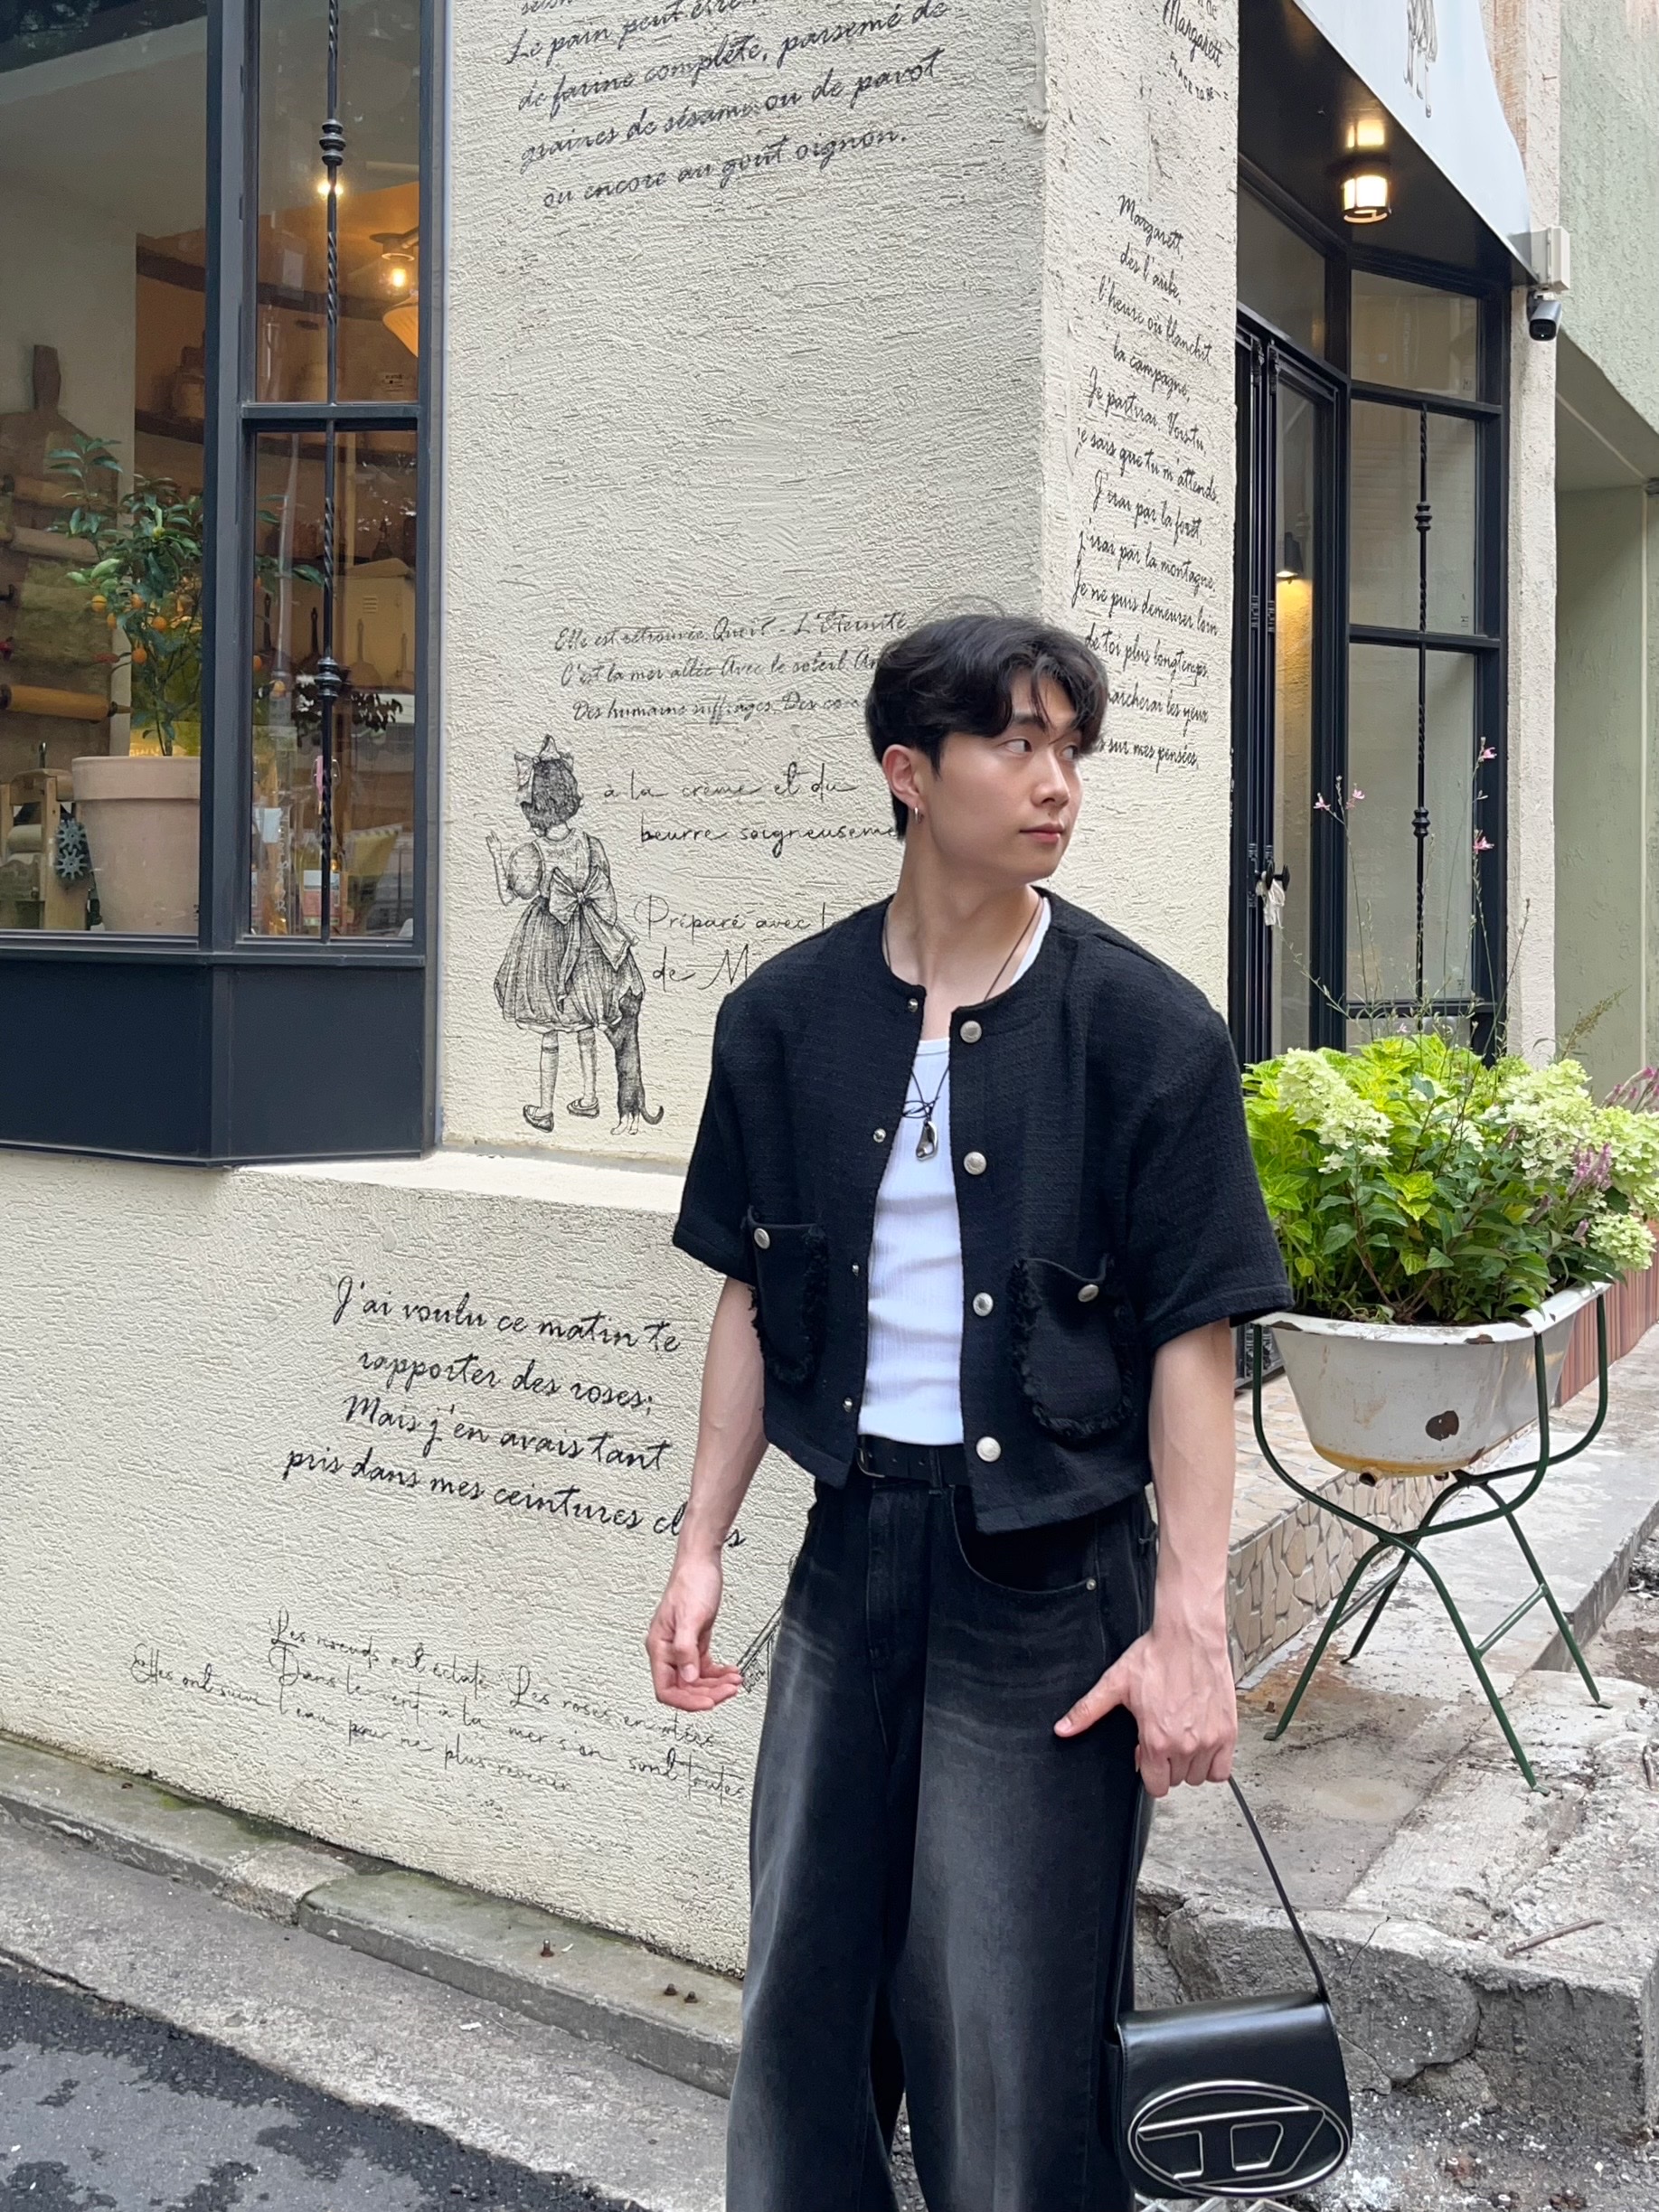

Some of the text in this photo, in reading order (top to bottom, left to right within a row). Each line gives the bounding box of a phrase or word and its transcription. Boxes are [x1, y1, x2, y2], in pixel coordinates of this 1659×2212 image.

[506, 29, 543, 65] Le
[546, 23, 613, 67] pain
[518, 80, 547, 110] de
[777, 4, 902, 70] parsemé
[911, 0, 949, 24] de
[520, 127, 619, 174] graines
[627, 108, 658, 141] de
[811, 67, 845, 101] de
[850, 47, 946, 109] pavot
[583, 171, 667, 202] encore
[1114, 333, 1126, 362] la
[1089, 366, 1103, 409] Je
[1091, 432, 1117, 457] sais
[1119, 447, 1143, 477] que
[1145, 448, 1160, 475] tu
[1134, 503, 1157, 529] par
[1160, 500, 1173, 529] la
[1117, 545, 1141, 571] par
[1145, 541, 1158, 568] la
[1091, 588, 1108, 603] ne
[1108, 588, 1139, 619] puis
[1141, 589, 1194, 628] demeurer
[1197, 606, 1219, 636] loin
[554, 626, 589, 651] Elle
[1085, 622, 1100, 651] de
[1102, 627, 1121, 656] toi
[1122, 634, 1150, 672] plus
[607, 663, 623, 682] la
[631, 668, 664, 682] mer
[771, 653, 786, 673] le
[1166, 689, 1181, 716] les
[1108, 738, 1130, 756] sur
[1133, 742, 1155, 759] mes
[631, 768, 669, 800] la
[774, 761, 810, 795] et
[811, 762, 858, 804] du
[641, 813, 897, 859] beurre soigneuseme
[756, 917, 812, 930] avec
[652, 946, 696, 993] de
[333, 1275, 682, 1352] J'ai voulu ce matin te
[358, 1351, 502, 1392] rapporter
[513, 1359, 561, 1396] des
[343, 1395, 673, 1471] Mais j'en avais tant
[281, 1446, 344, 1481] pris
[351, 1446, 421, 1489] dans
[430, 1476, 486, 1501] mes
[494, 1483, 645, 1530] ceintures
[463, 1695, 492, 1729] la
[508, 1726, 550, 1746] mer
[444, 1733, 487, 1771] plus
